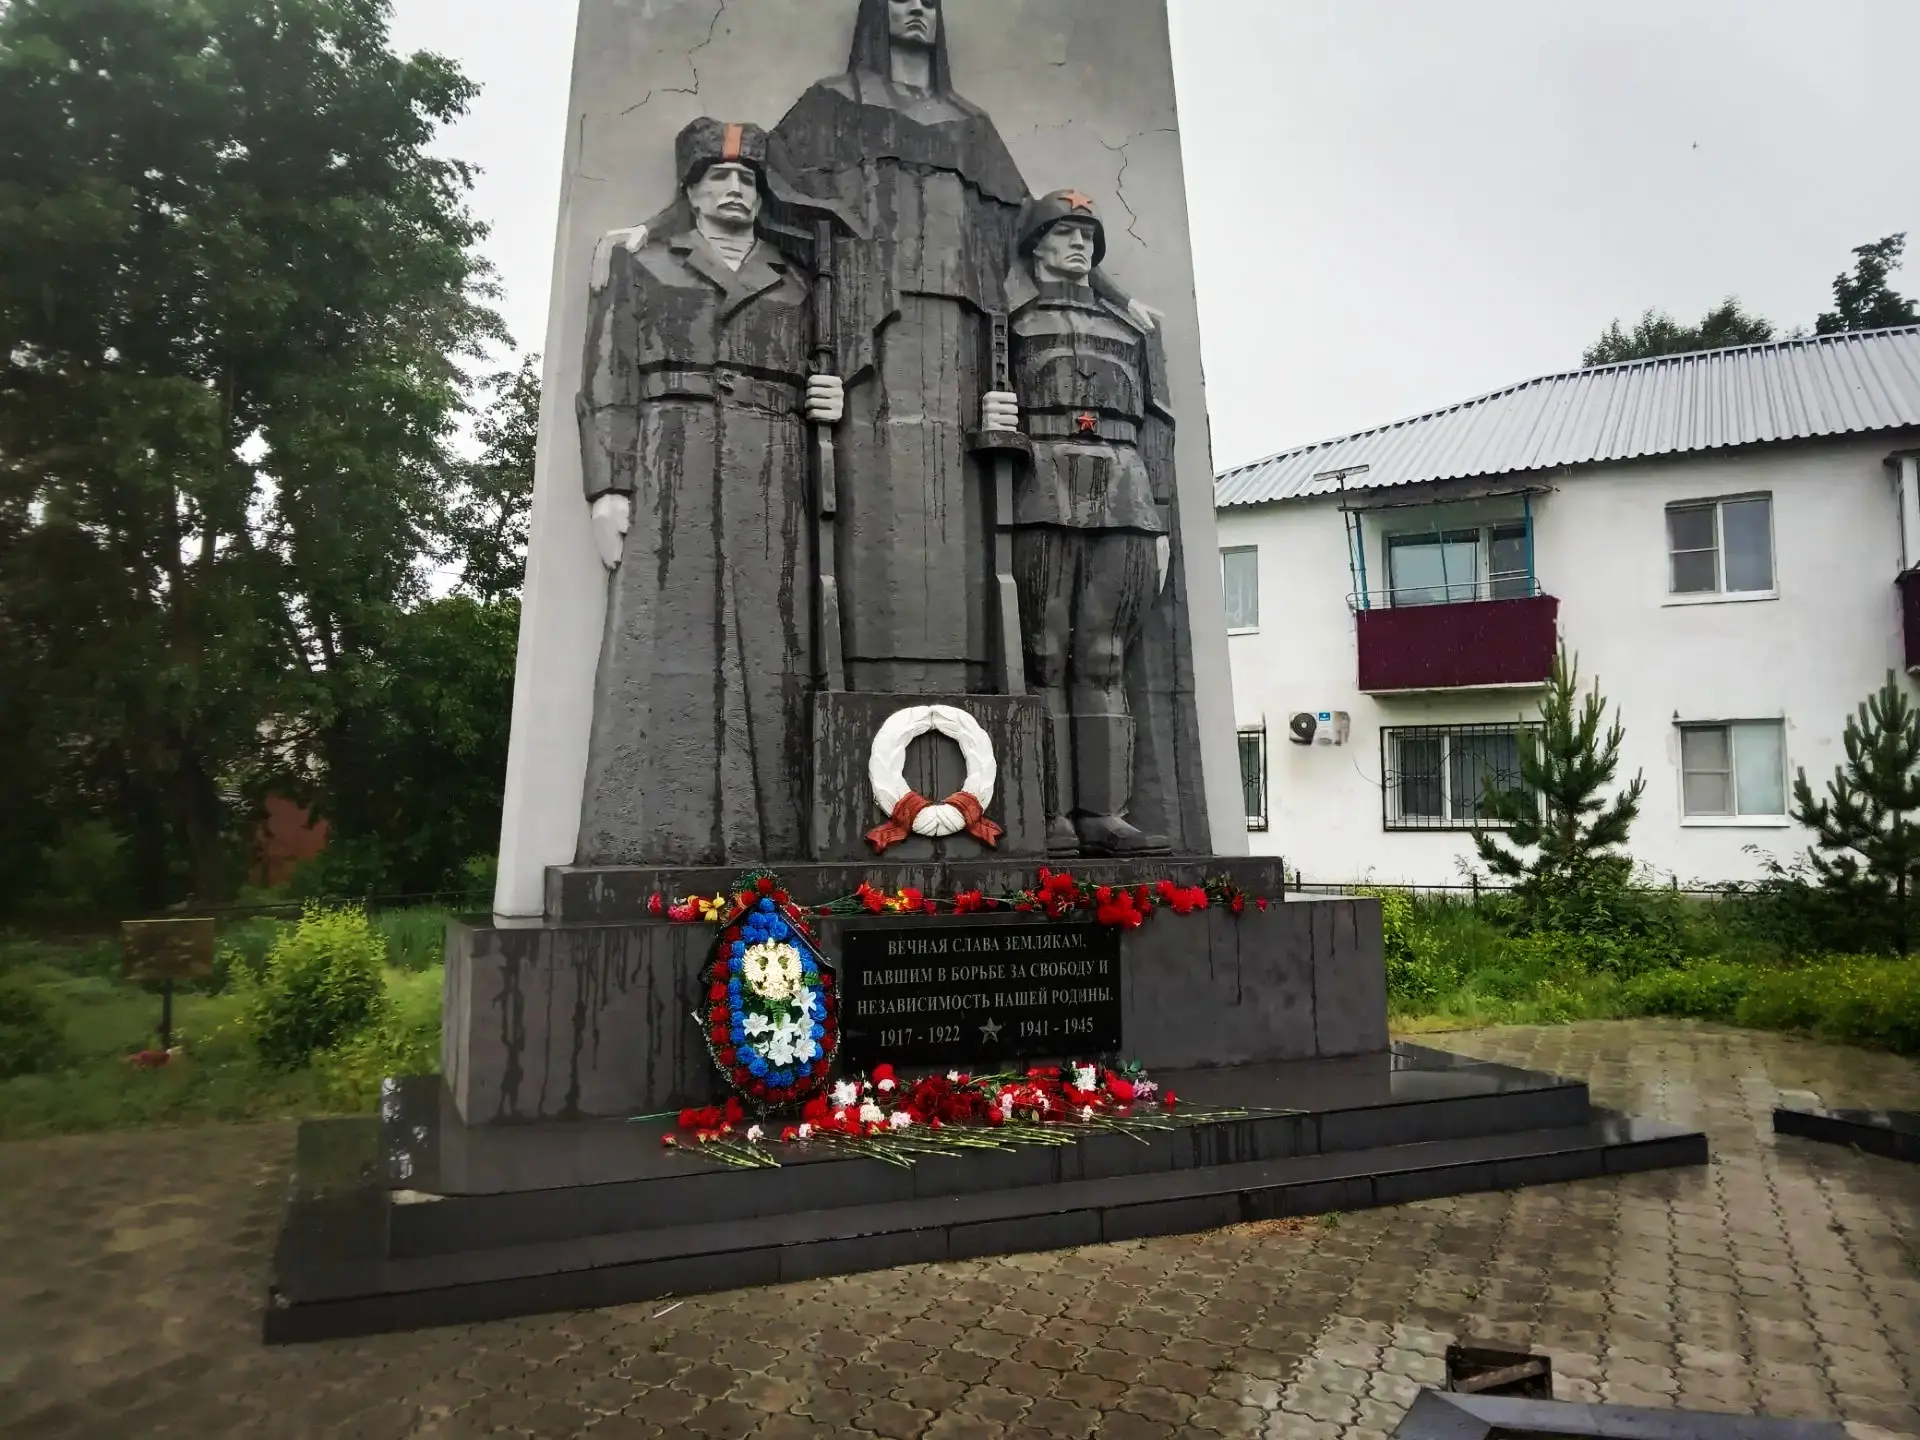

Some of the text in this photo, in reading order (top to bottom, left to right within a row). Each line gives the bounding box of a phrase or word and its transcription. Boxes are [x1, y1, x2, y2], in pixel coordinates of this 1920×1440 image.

[888, 937, 947, 955] ВЕЧНАЯ
[952, 937, 999, 952] СЛАВА
[862, 960, 1108, 986] ПАВШИМ В БОРЬБЕ ЗА СВОБОДУ И
[857, 987, 1114, 1015] НЕЗАВИСИМОСТЬ НАШЕЙ РОДИНЫ.
[880, 1028, 912, 1047] 1917
[928, 1025, 960, 1043] 1922
[1019, 1020, 1049, 1037] 1941
[1064, 1017, 1093, 1034] 1945
